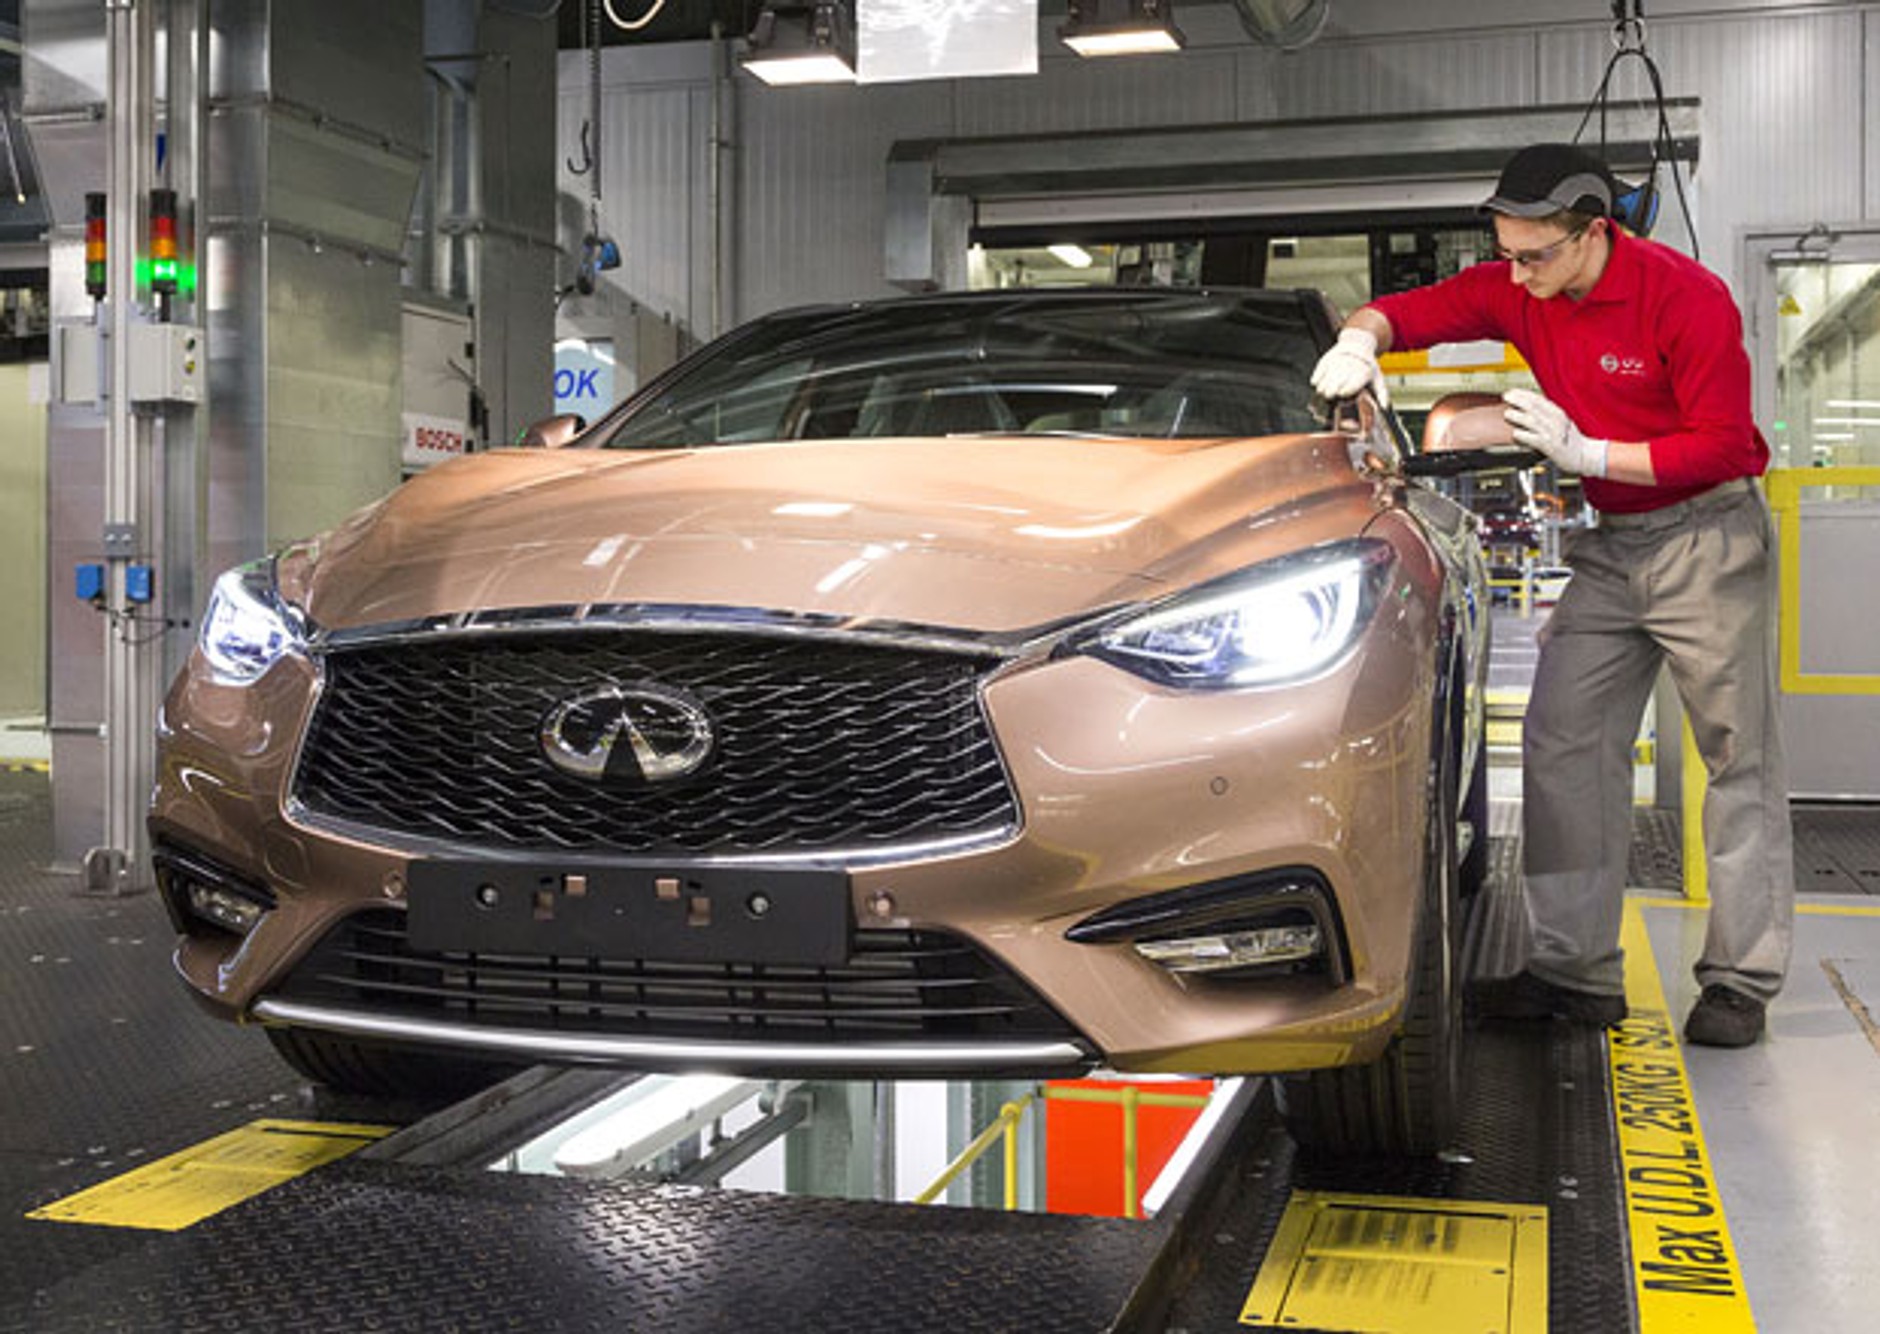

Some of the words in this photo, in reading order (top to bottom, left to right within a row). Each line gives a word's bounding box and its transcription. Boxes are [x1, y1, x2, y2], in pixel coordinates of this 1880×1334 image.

[415, 427, 462, 452] BOSCH
[1615, 1063, 1693, 1134] 250KG
[1640, 1225, 1736, 1296] Max
